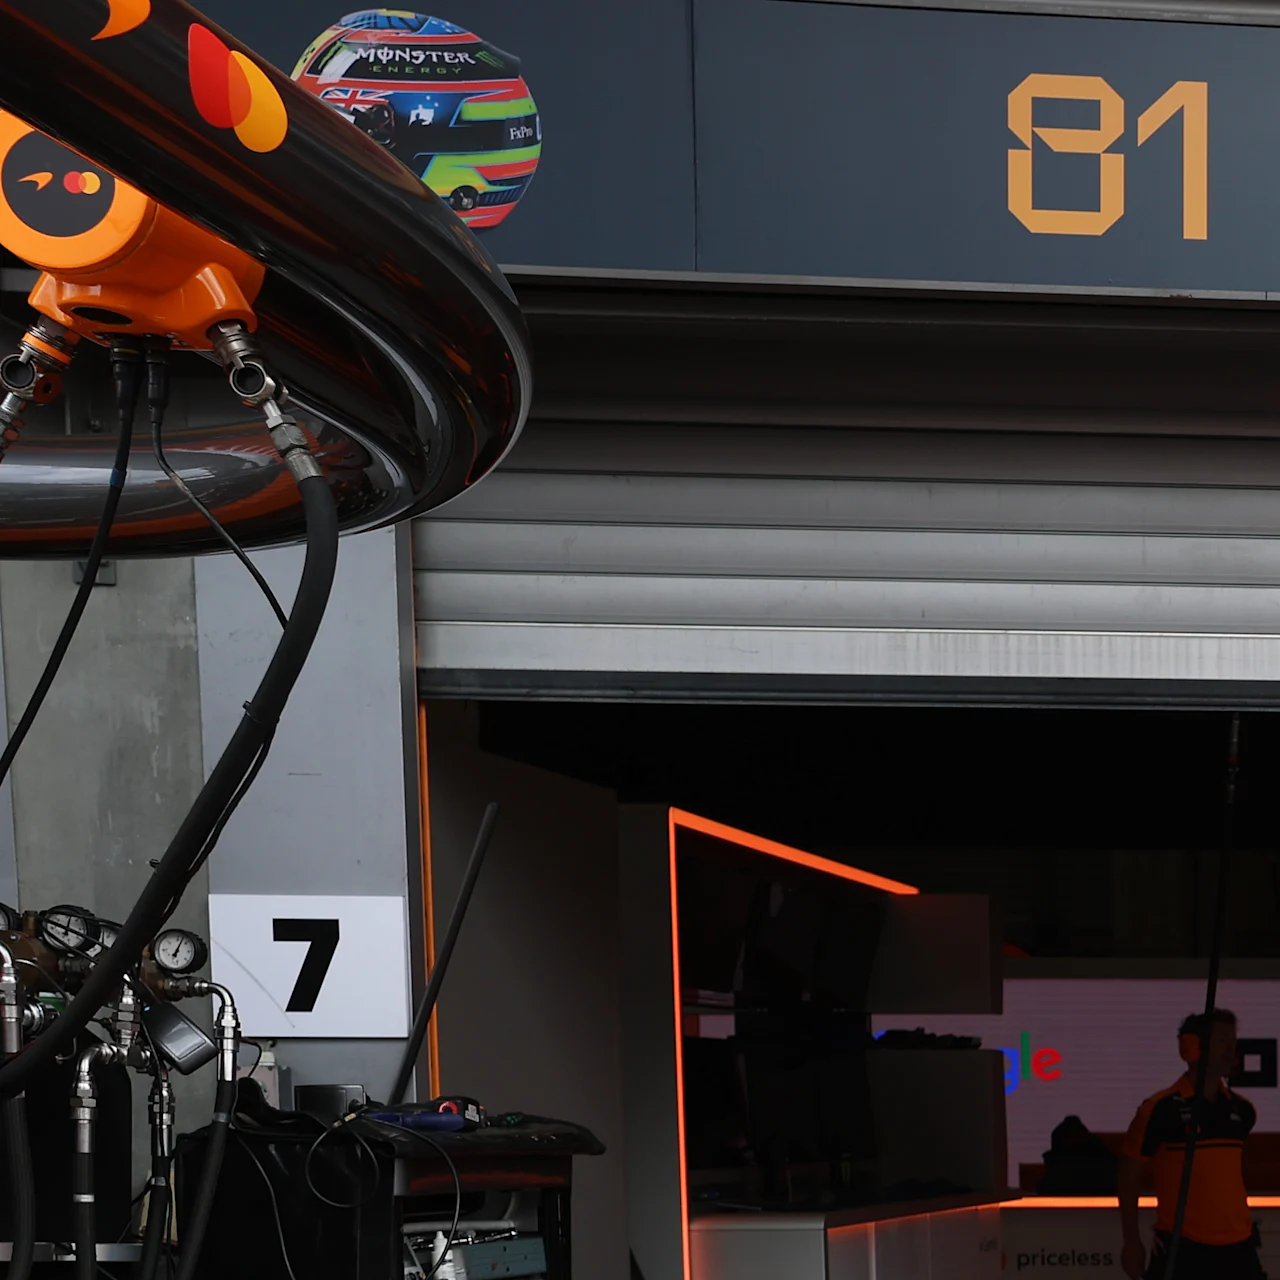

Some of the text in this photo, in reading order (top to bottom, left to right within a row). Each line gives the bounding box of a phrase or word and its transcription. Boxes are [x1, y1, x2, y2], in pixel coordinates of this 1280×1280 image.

[371, 65, 464, 75] ENERGY
[509, 124, 535, 142] FxPro
[1006, 74, 1209, 240] 81
[272, 918, 341, 1014] 7
[1017, 1249, 1114, 1271] priceless
